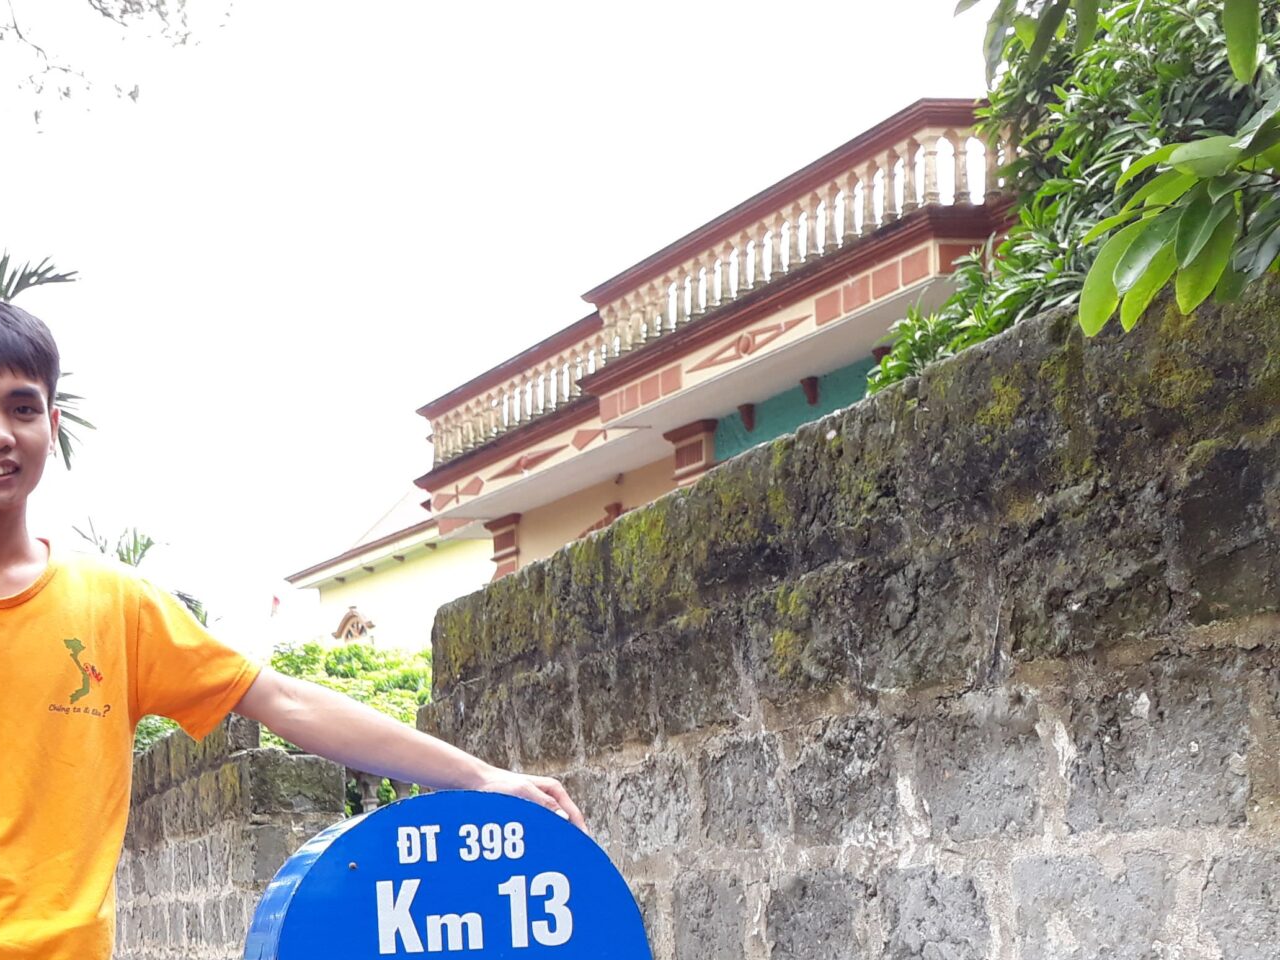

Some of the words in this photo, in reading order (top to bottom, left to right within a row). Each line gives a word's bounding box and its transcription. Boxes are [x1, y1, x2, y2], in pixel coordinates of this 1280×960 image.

[396, 824, 440, 865] ĐT
[458, 821, 525, 861] 398
[375, 878, 483, 955] Km
[497, 871, 574, 949] 13
